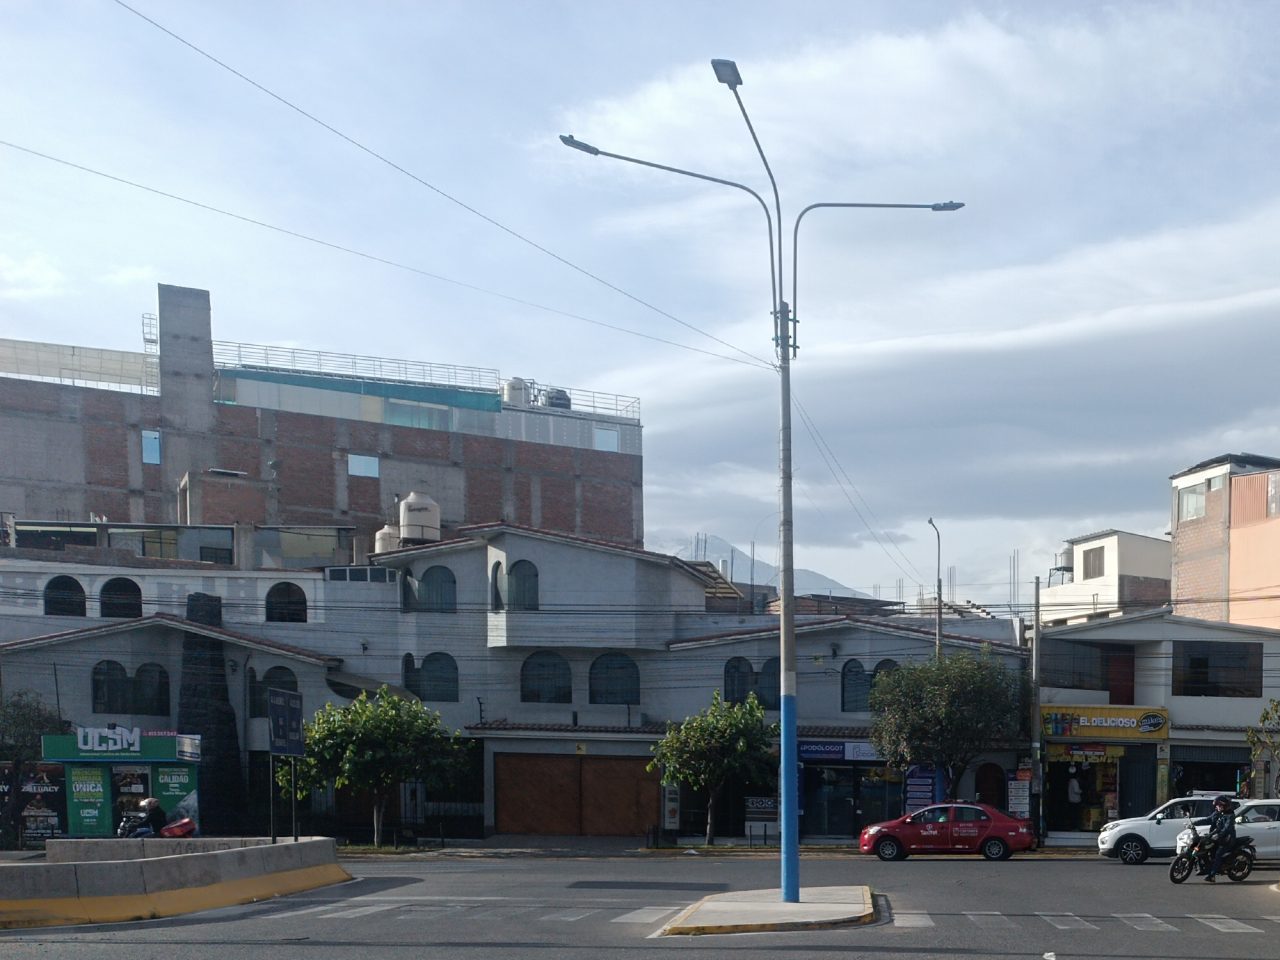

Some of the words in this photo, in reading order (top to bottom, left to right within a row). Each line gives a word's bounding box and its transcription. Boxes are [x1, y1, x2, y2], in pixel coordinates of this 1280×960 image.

[1079, 717, 1090, 726] EL
[1091, 717, 1137, 727] DELICIOSO
[77, 727, 140, 751] UCSM
